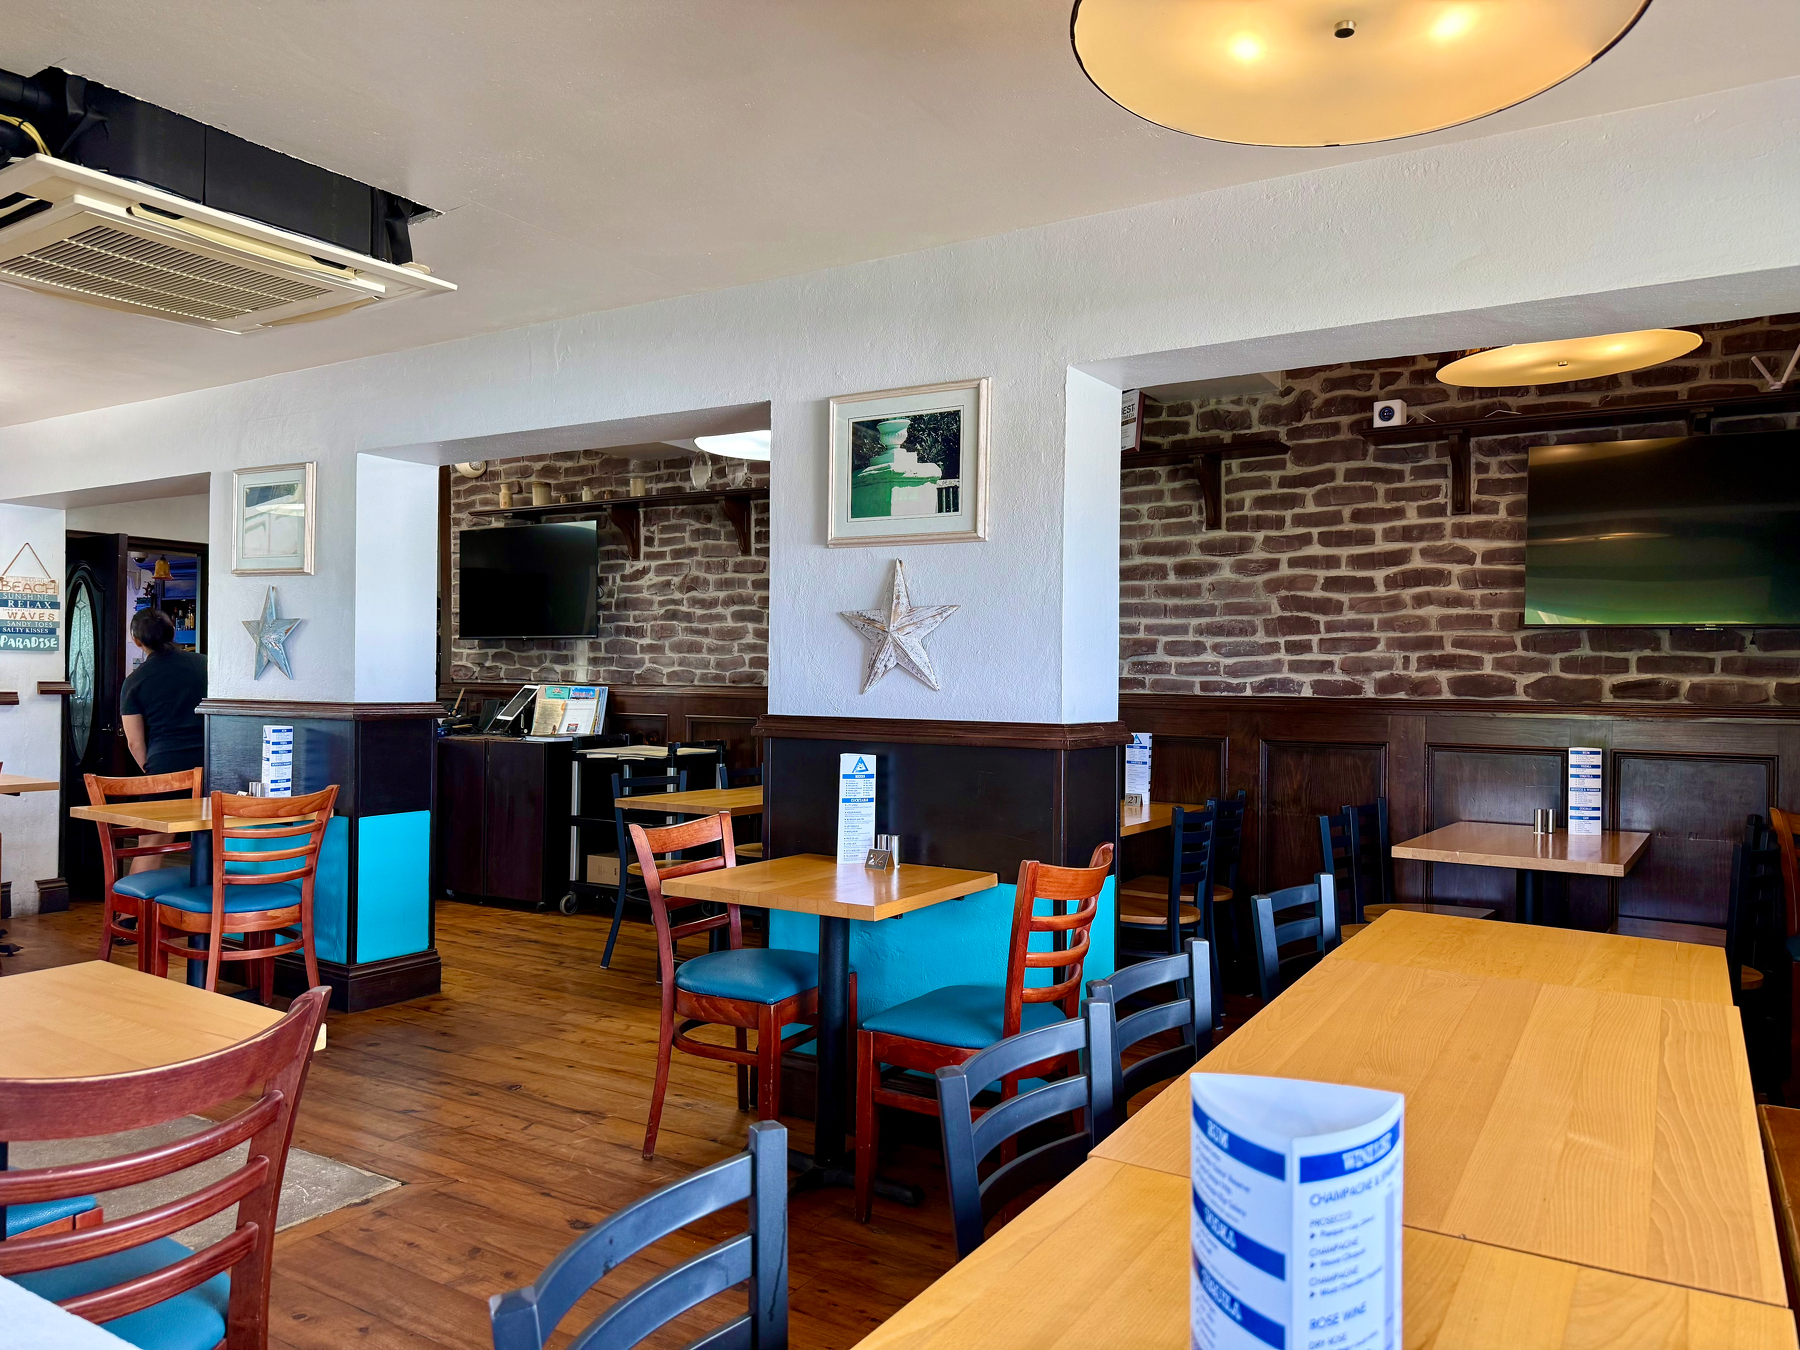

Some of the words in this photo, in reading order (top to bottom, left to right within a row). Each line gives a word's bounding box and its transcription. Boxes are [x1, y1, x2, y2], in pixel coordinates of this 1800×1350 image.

[0, 581, 56, 593] BEACH
[8, 600, 51, 609] RELAX
[7, 612, 55, 621] WAVES
[1127, 795, 1138, 804] 21
[1309, 1178, 1373, 1207] CHAMPAGNE
[1309, 1210, 1353, 1228] PROSECCO
[1309, 1312, 1340, 1330] ROSE
[1343, 1300, 1367, 1321] WINE
